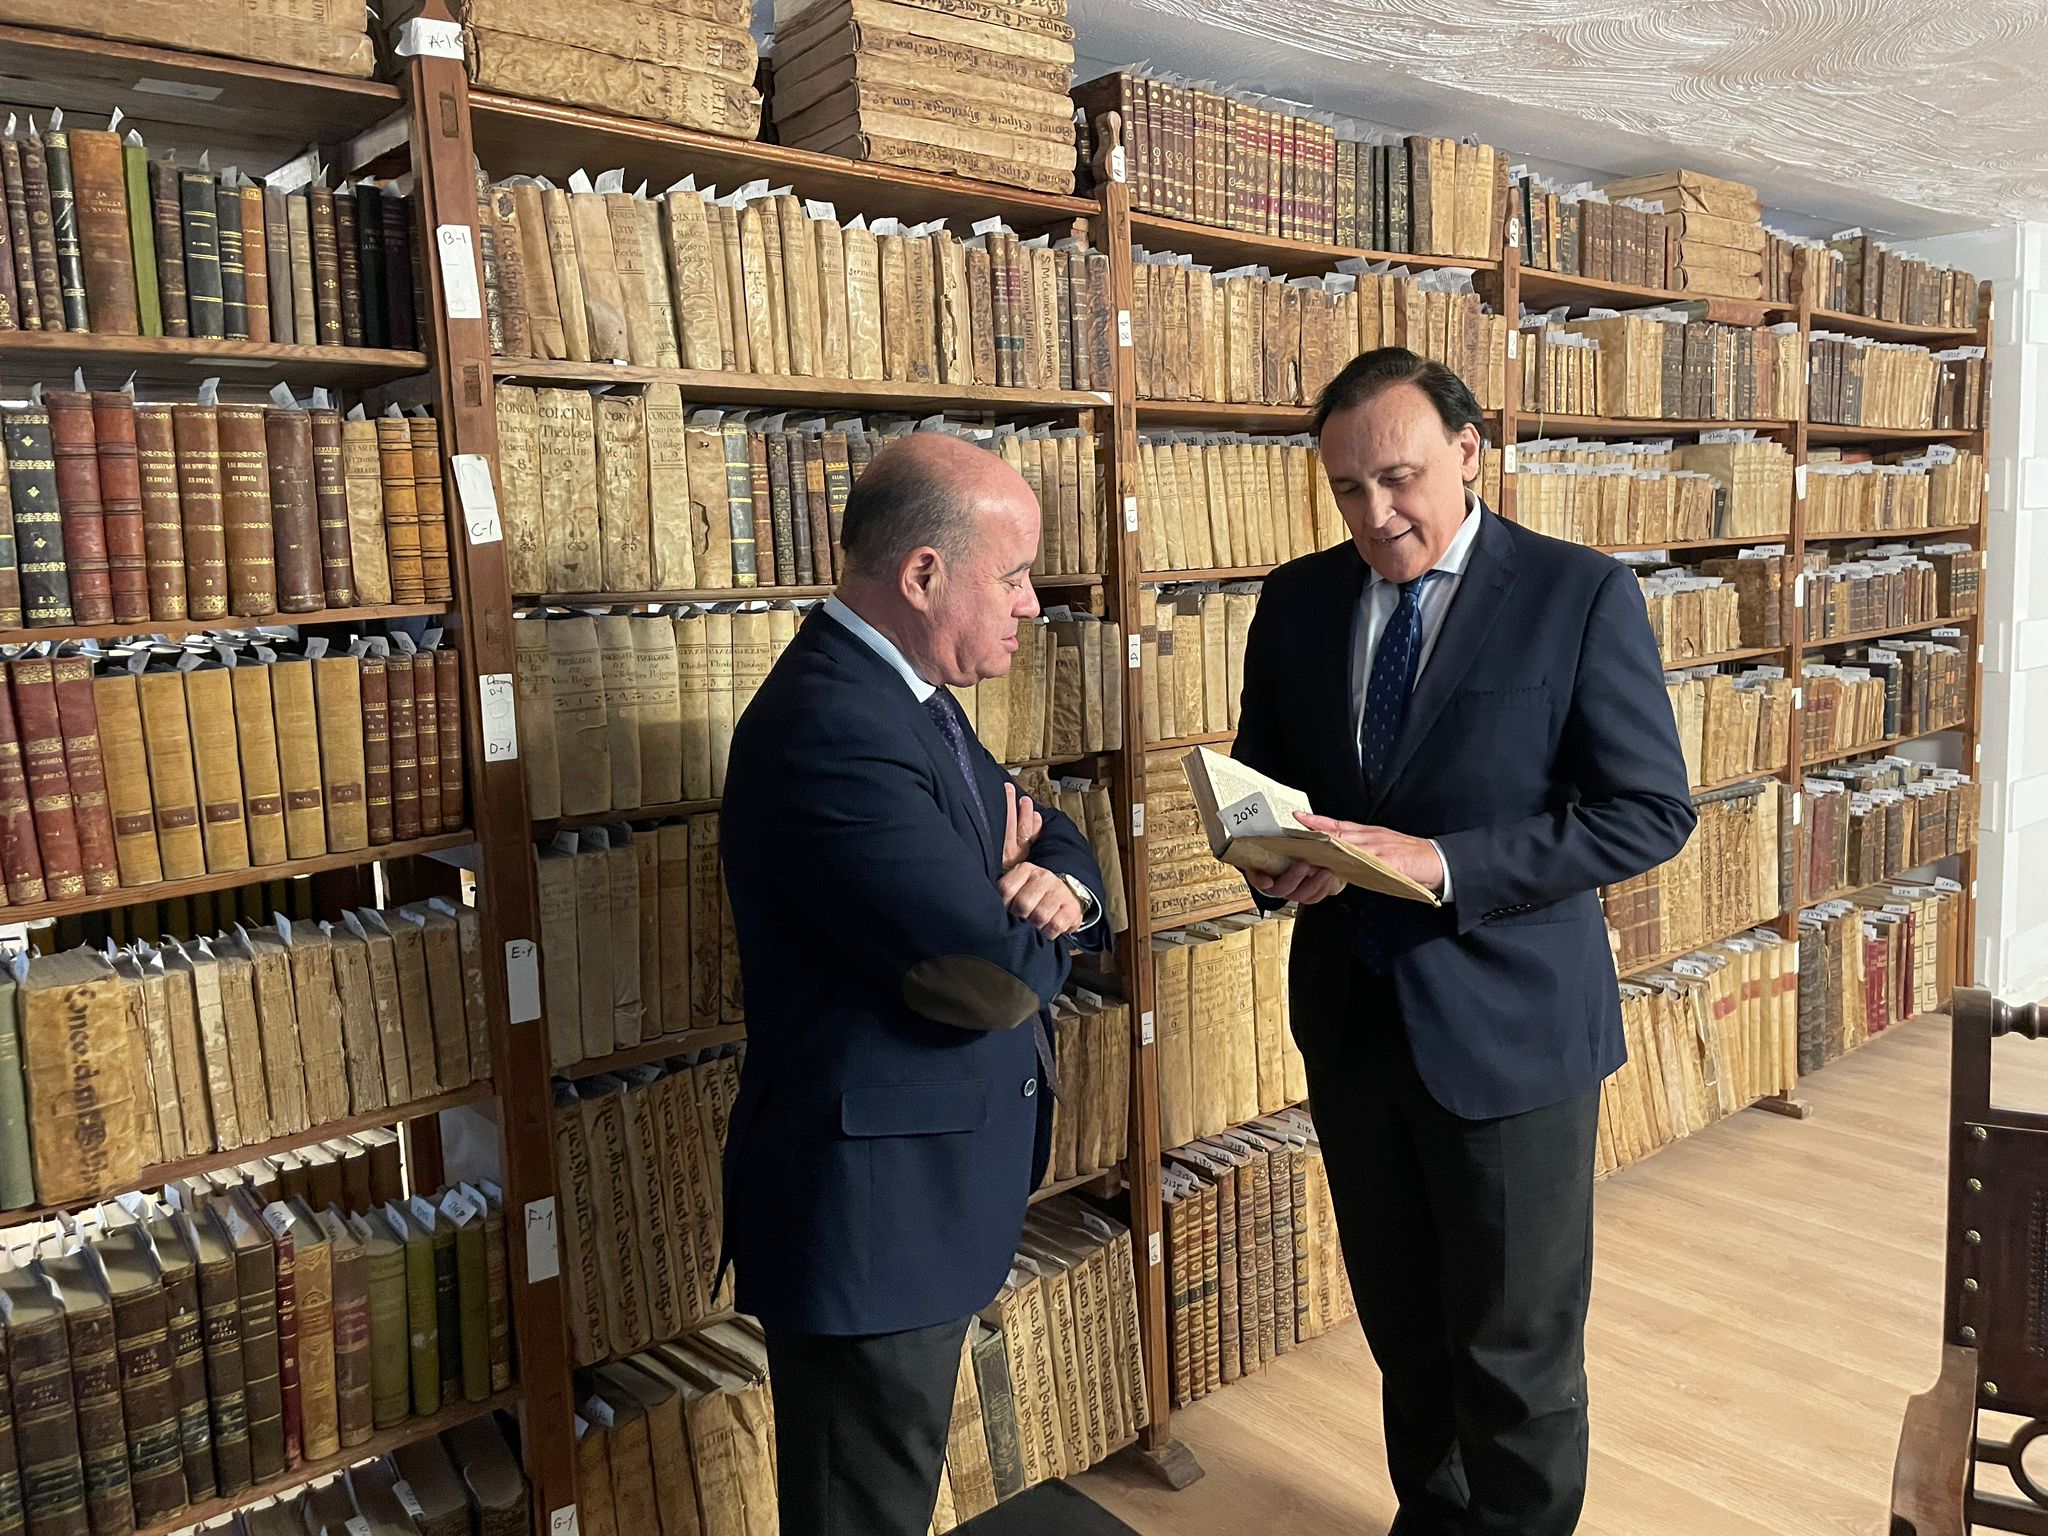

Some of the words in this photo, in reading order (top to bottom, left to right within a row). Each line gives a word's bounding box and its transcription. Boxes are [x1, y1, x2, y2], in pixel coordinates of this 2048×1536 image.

[443, 230, 466, 245] B-1
[471, 520, 493, 537] C-1
[490, 741, 511, 754] D-1
